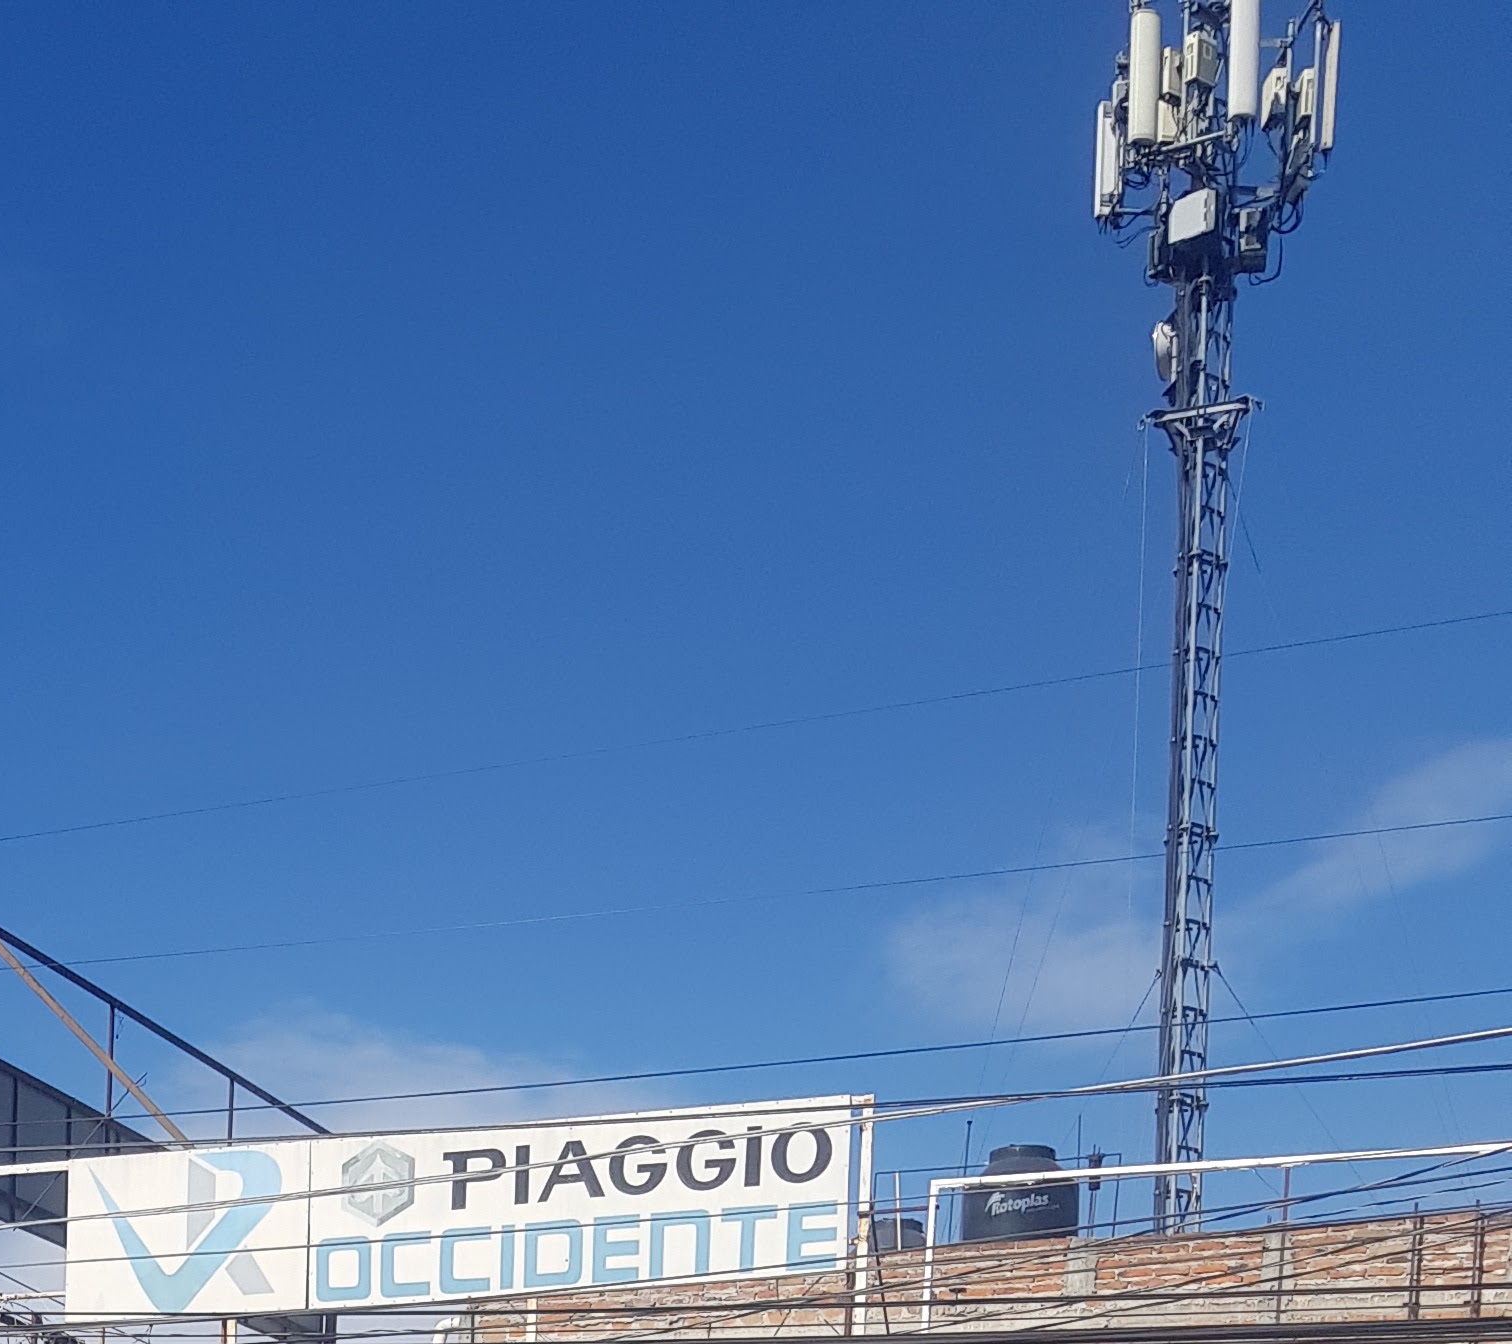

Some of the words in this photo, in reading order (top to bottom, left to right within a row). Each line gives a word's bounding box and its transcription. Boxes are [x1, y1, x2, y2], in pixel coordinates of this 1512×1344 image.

[443, 1122, 833, 1210] PIAGGIO
[991, 1192, 1050, 1216] Rotoplas
[316, 1200, 838, 1301] OCCIDENTE
